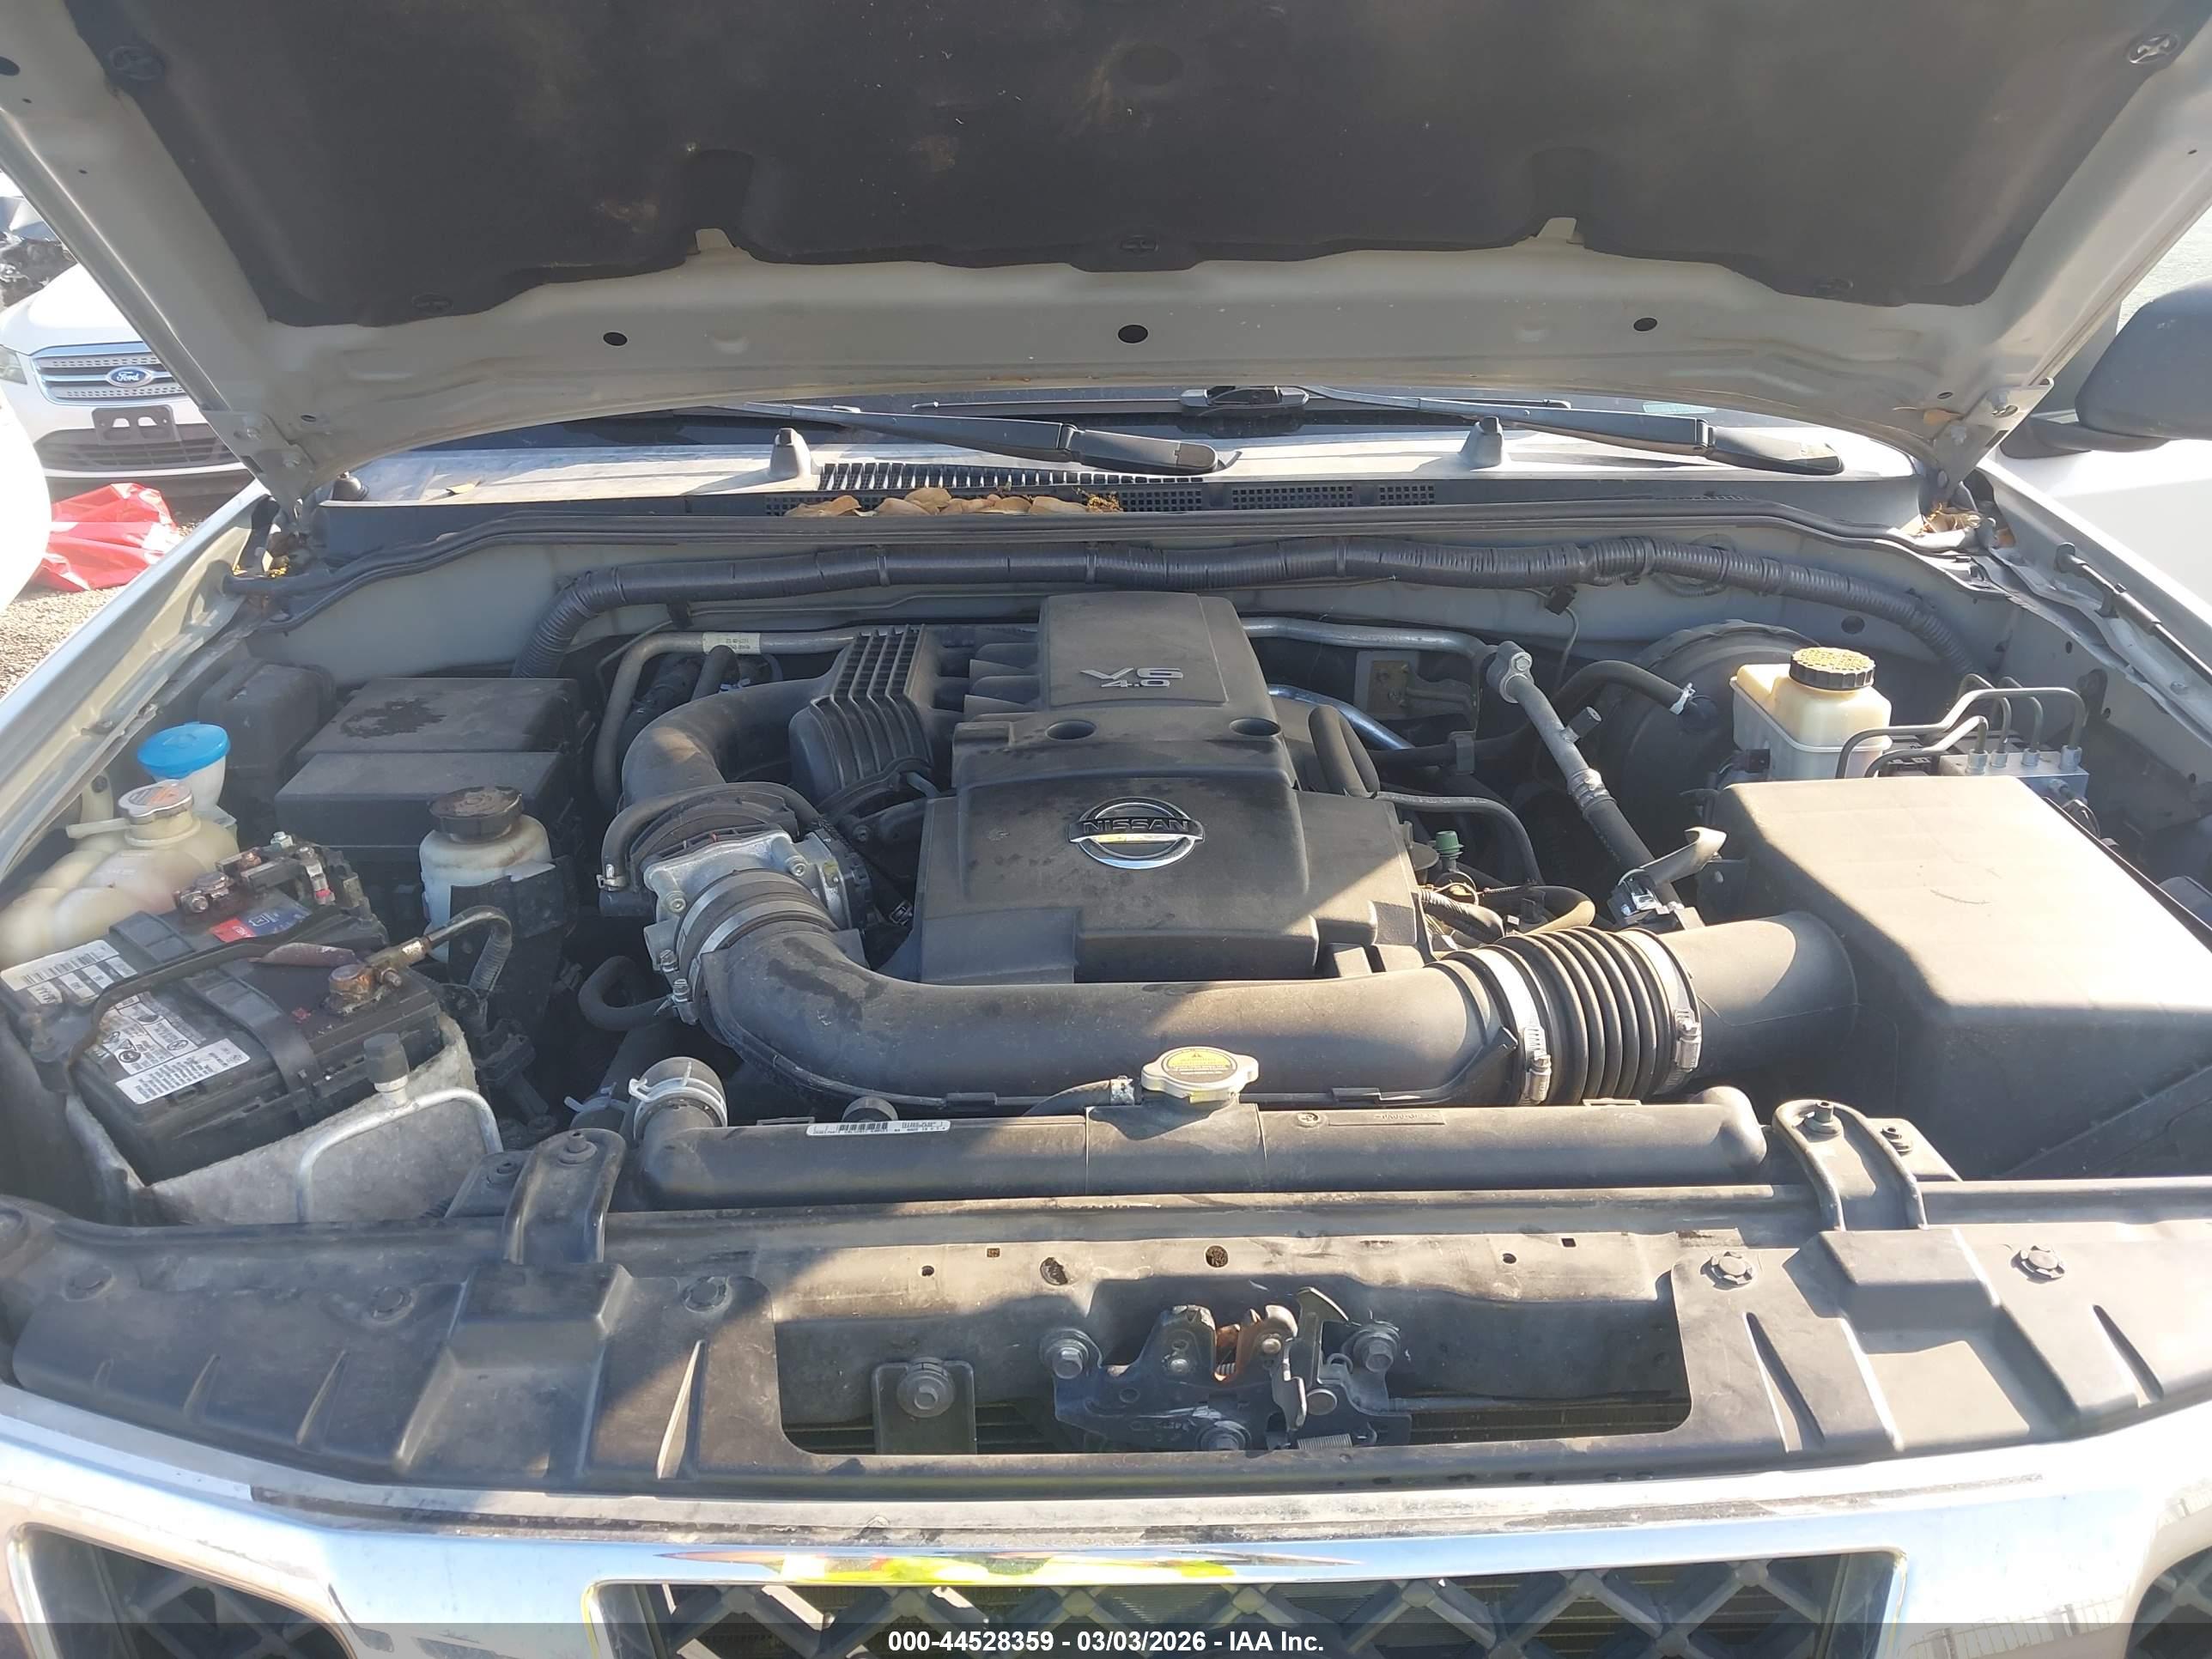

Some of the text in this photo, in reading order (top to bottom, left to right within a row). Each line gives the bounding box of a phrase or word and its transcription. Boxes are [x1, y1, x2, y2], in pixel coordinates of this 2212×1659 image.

[116, 371, 140, 382] Ford
[1101, 678, 1170, 688] 4.0
[1082, 818, 1189, 834] NISSAN
